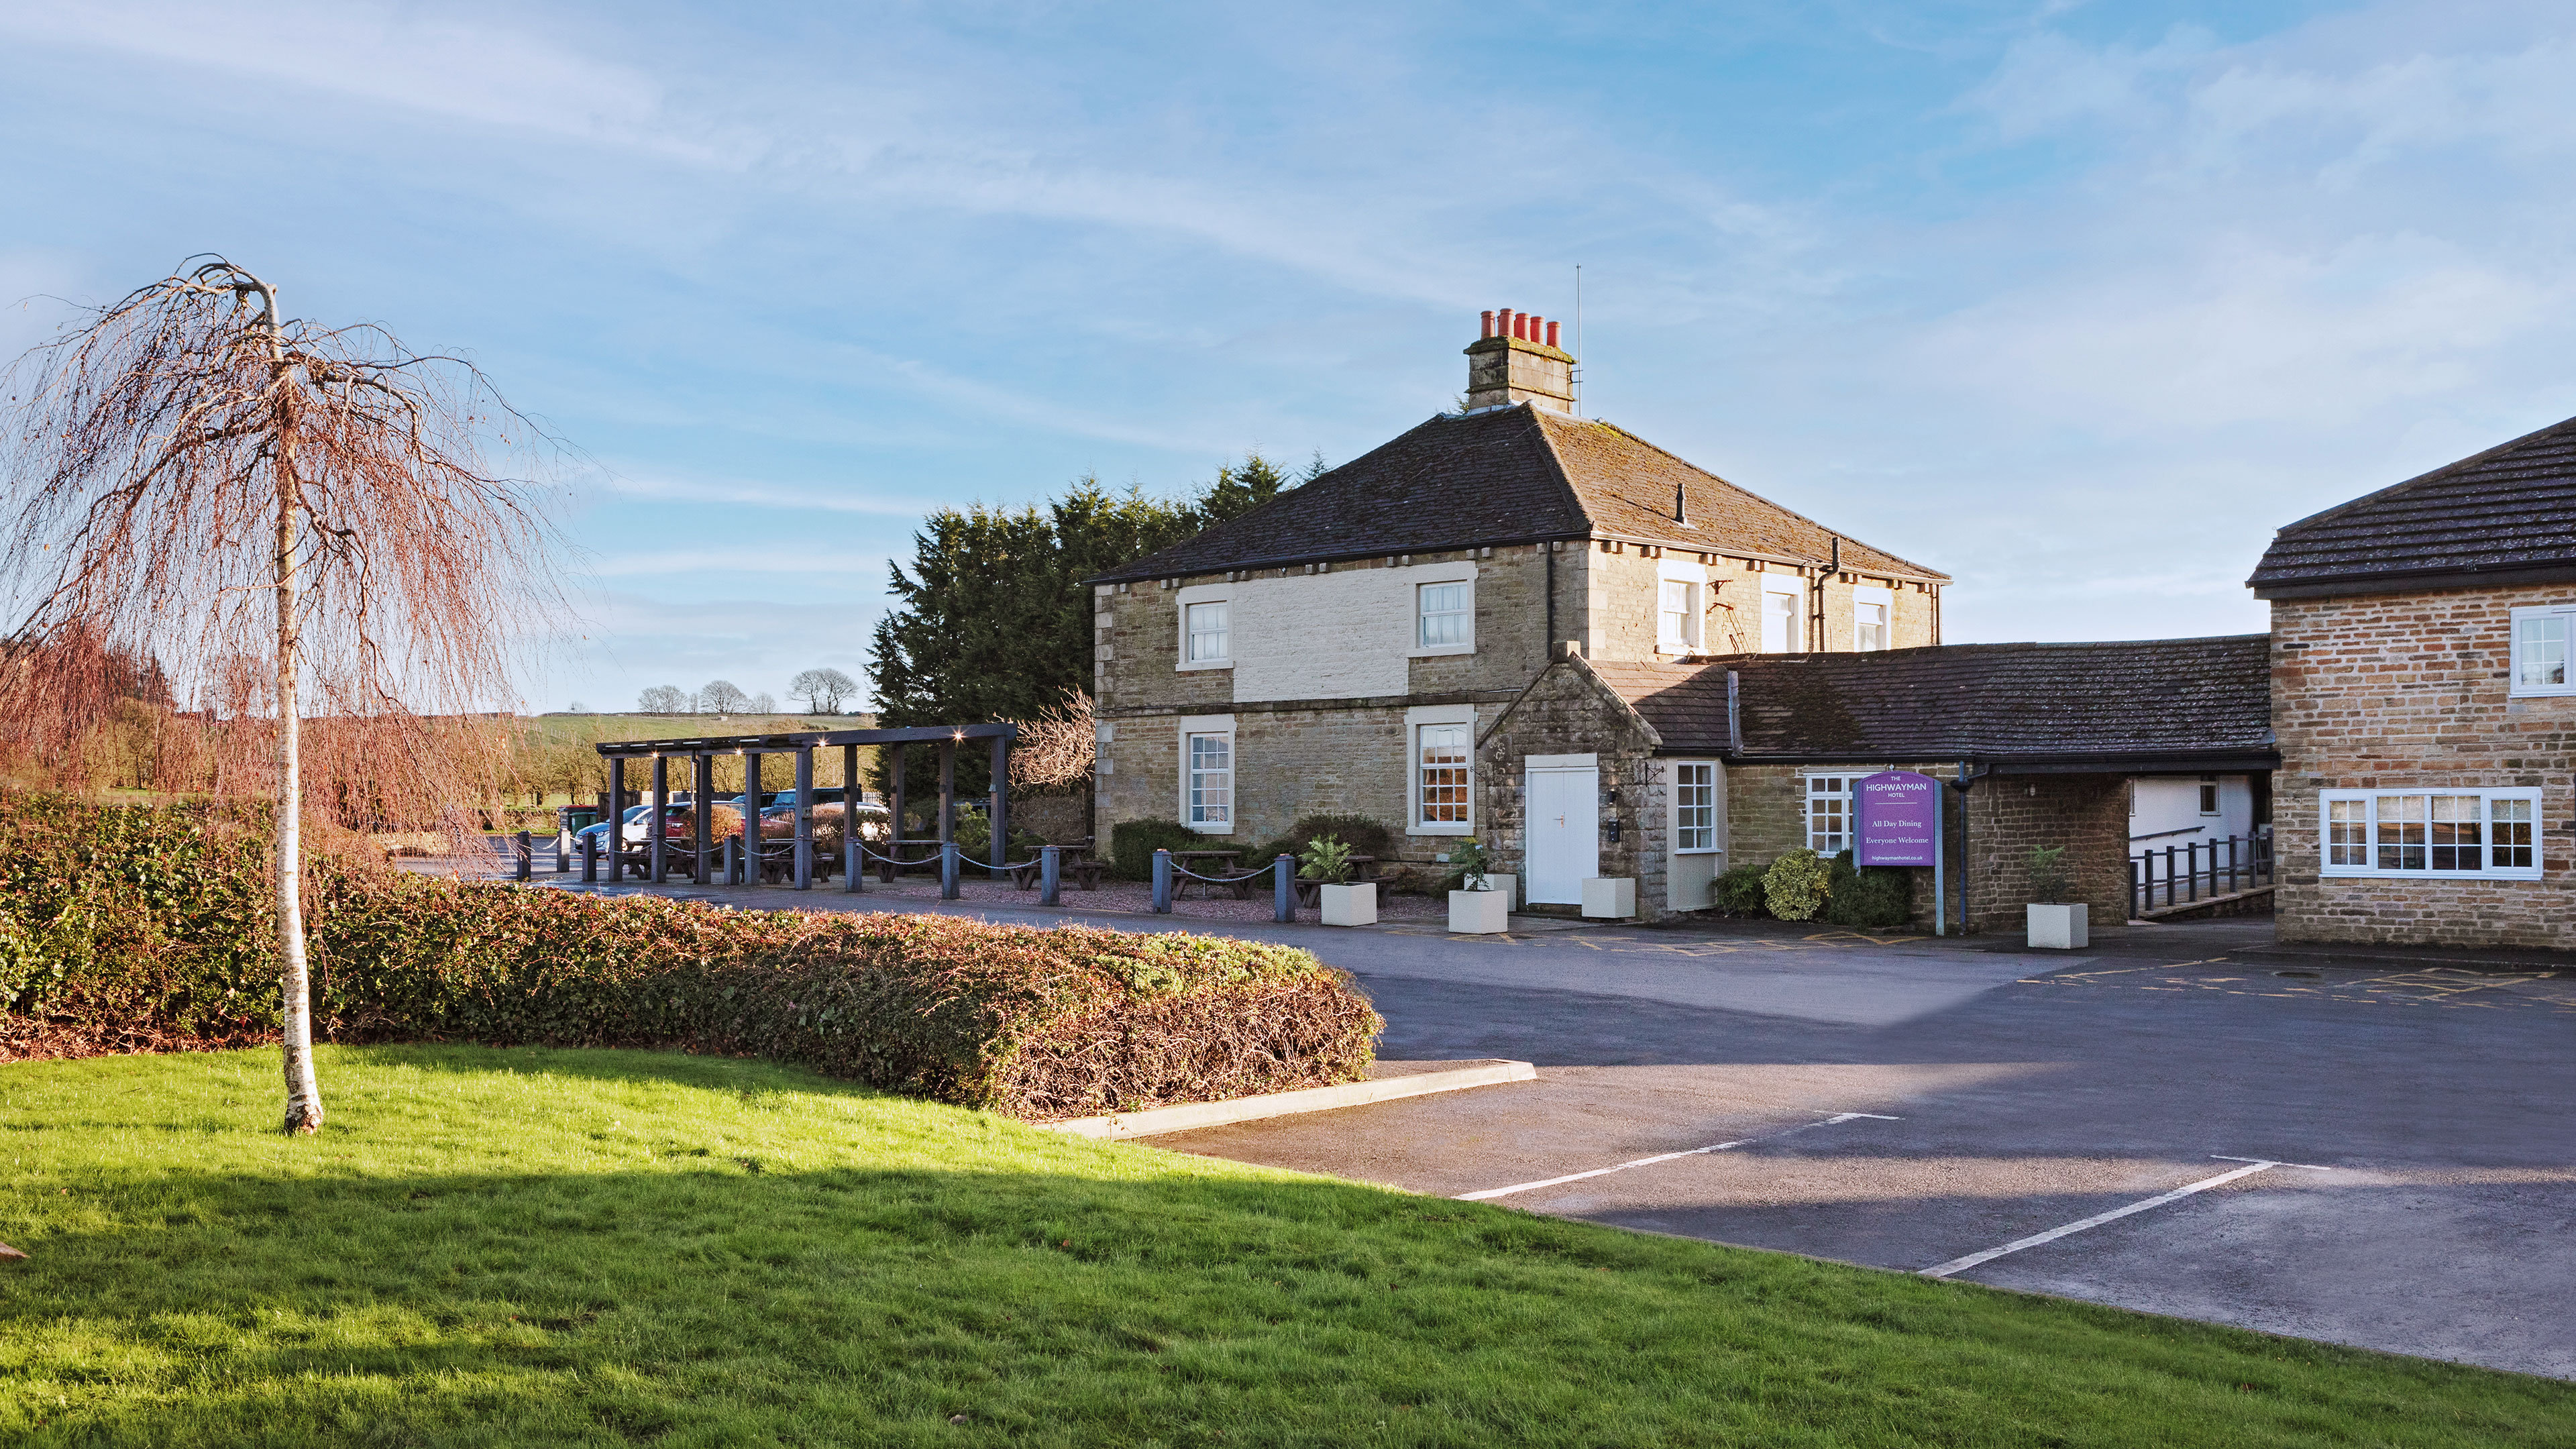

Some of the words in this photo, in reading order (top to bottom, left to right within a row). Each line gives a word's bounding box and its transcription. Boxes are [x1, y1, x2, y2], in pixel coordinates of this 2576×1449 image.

[1866, 783, 1927, 792] HIGHWAYMAN
[1884, 820, 1897, 828] Day
[1898, 820, 1922, 828] Dining
[1866, 837, 1896, 845] Everyone
